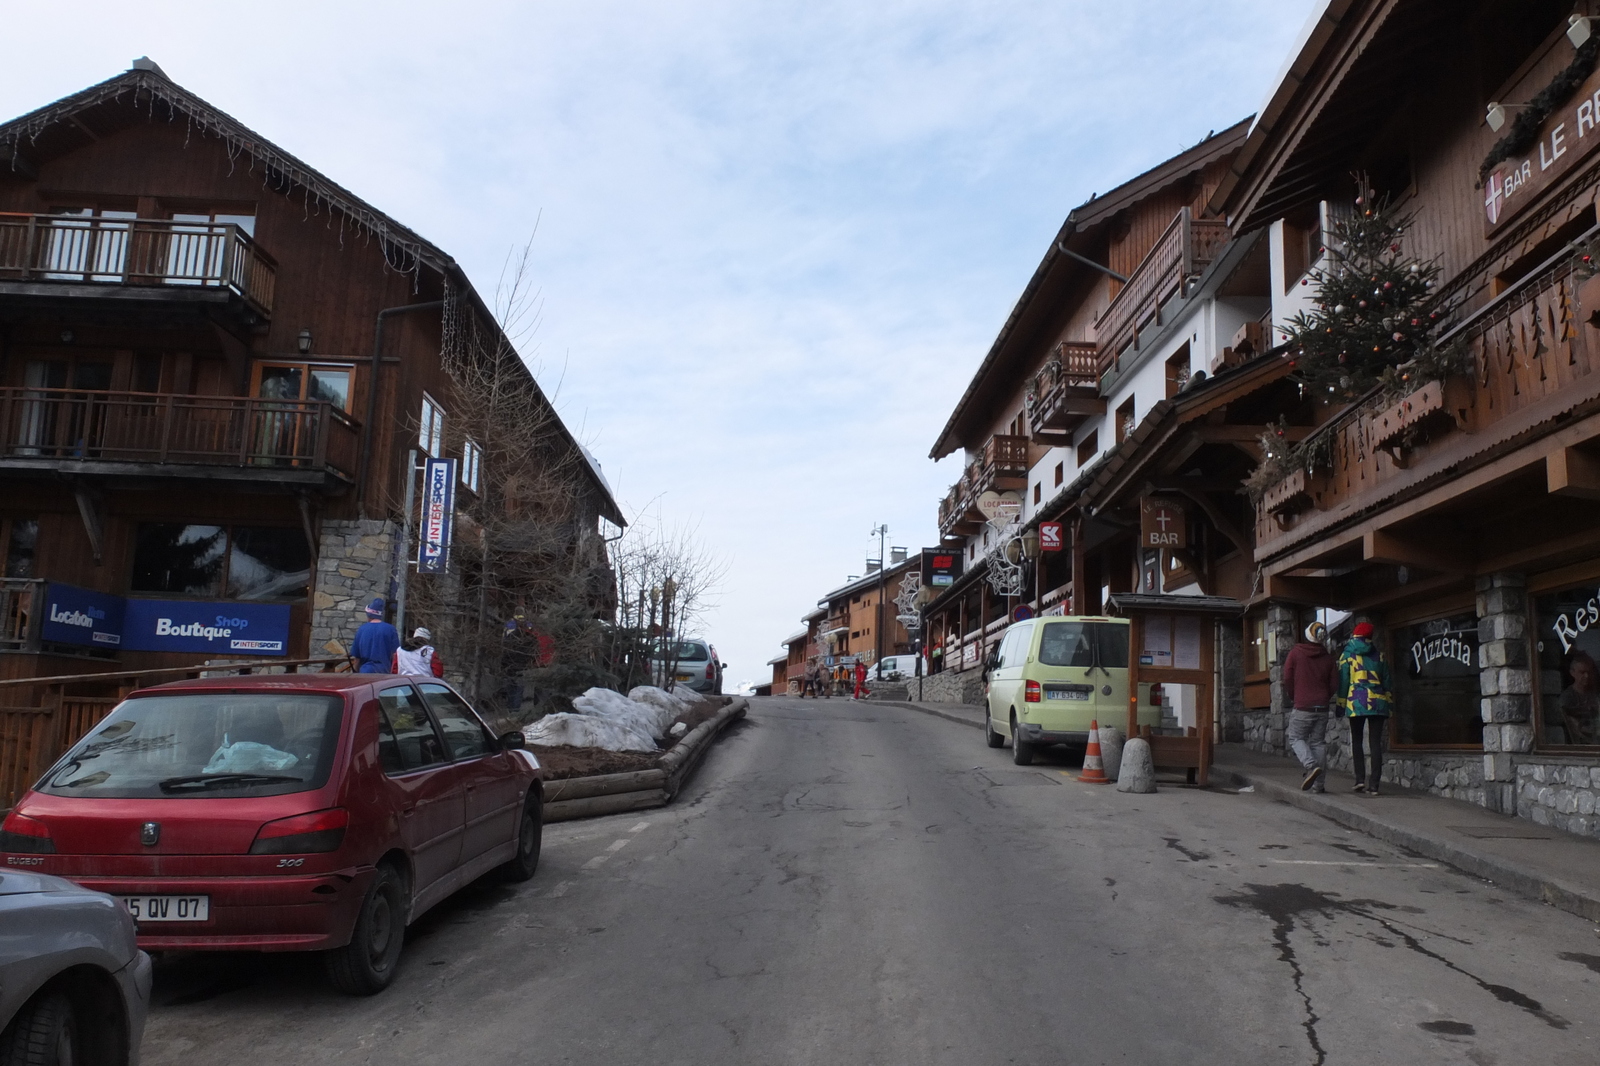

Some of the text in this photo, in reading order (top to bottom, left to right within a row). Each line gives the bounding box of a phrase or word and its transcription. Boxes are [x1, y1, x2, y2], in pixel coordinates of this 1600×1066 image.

[1504, 159, 1531, 198] BAR
[1540, 122, 1567, 171] LE
[430, 468, 444, 540] INTERSPORT
[983, 500, 1018, 508] LOCATION
[1143, 500, 1184, 515] LE REFUGE
[1150, 533, 1178, 544] BAR
[50, 603, 93, 628] Location
[156, 618, 231, 641] Boutique
[240, 641, 280, 649] INTERSPORT
[1411, 628, 1471, 673] Pizzéria
[7, 857, 45, 865] EUGEOT
[276, 858, 305, 868] 306
[148, 898, 169, 918] QV
[177, 898, 199, 918] 07
